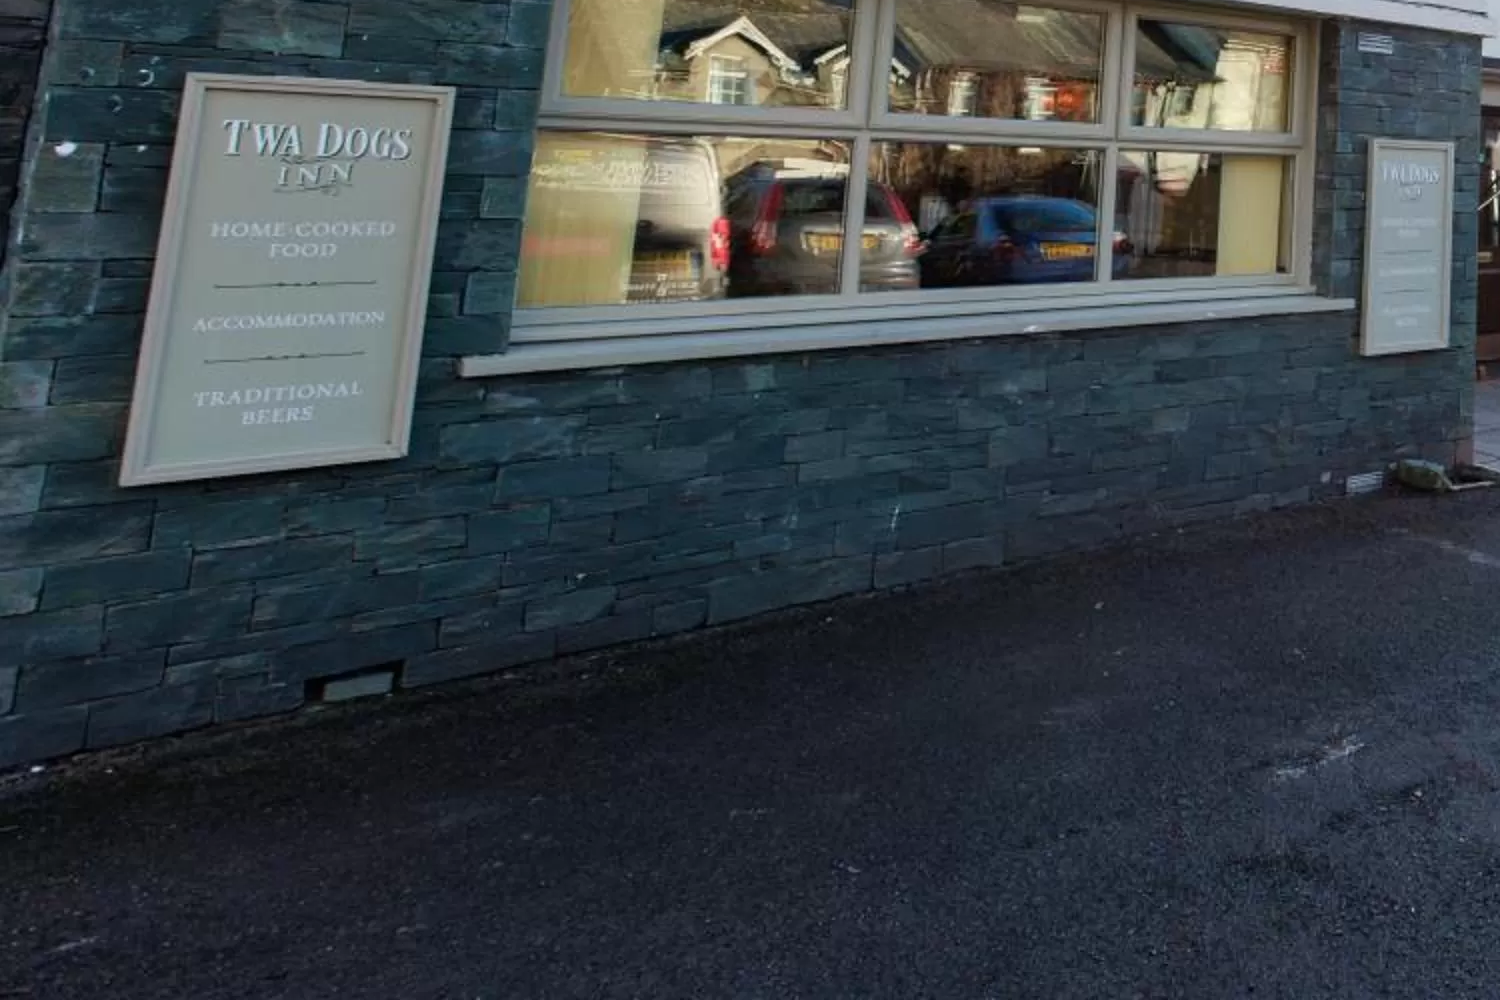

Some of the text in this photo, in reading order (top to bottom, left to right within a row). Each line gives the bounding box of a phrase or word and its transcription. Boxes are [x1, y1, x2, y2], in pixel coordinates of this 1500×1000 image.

[223, 119, 413, 160] TWA DOGS
[278, 162, 354, 187] INN
[268, 243, 338, 259] FOOD
[192, 311, 386, 333] ACCOMMODATION
[193, 380, 364, 407] TRADITIONAL
[241, 406, 314, 425] BEERS
